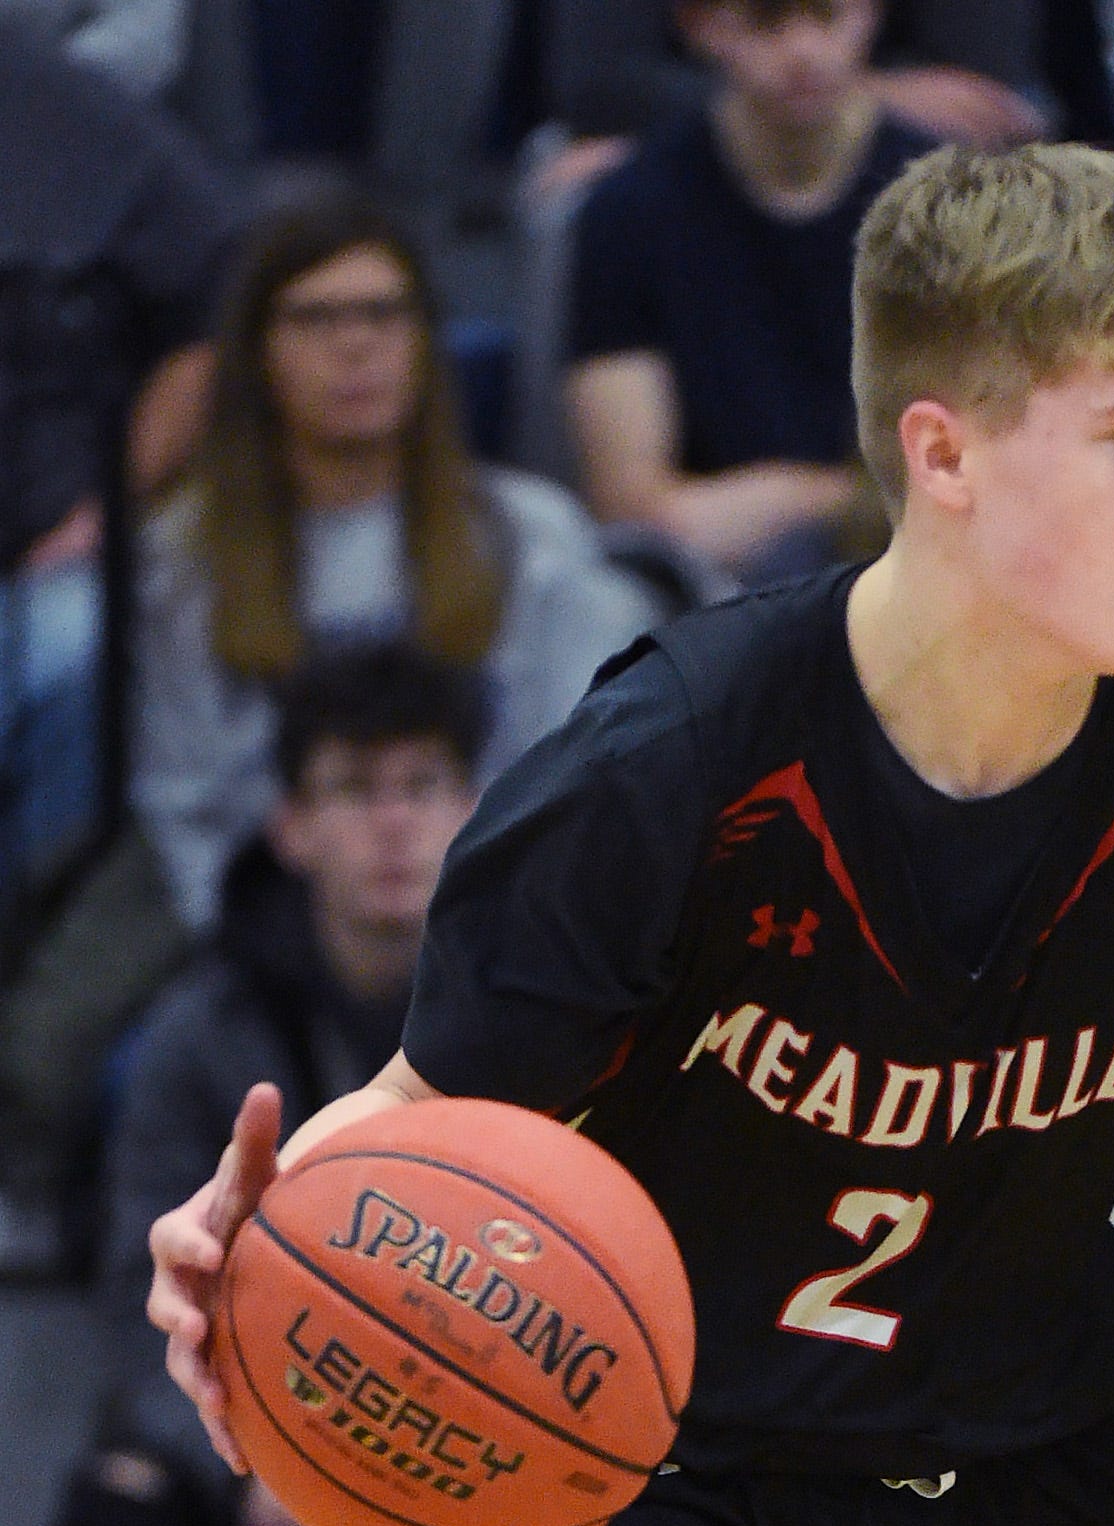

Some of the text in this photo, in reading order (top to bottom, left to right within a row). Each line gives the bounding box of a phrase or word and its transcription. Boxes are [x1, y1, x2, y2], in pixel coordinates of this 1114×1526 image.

[328, 1189, 618, 1412] SPALDING
[776, 1187, 934, 1352] 2
[286, 1307, 526, 1482] LEGACY
